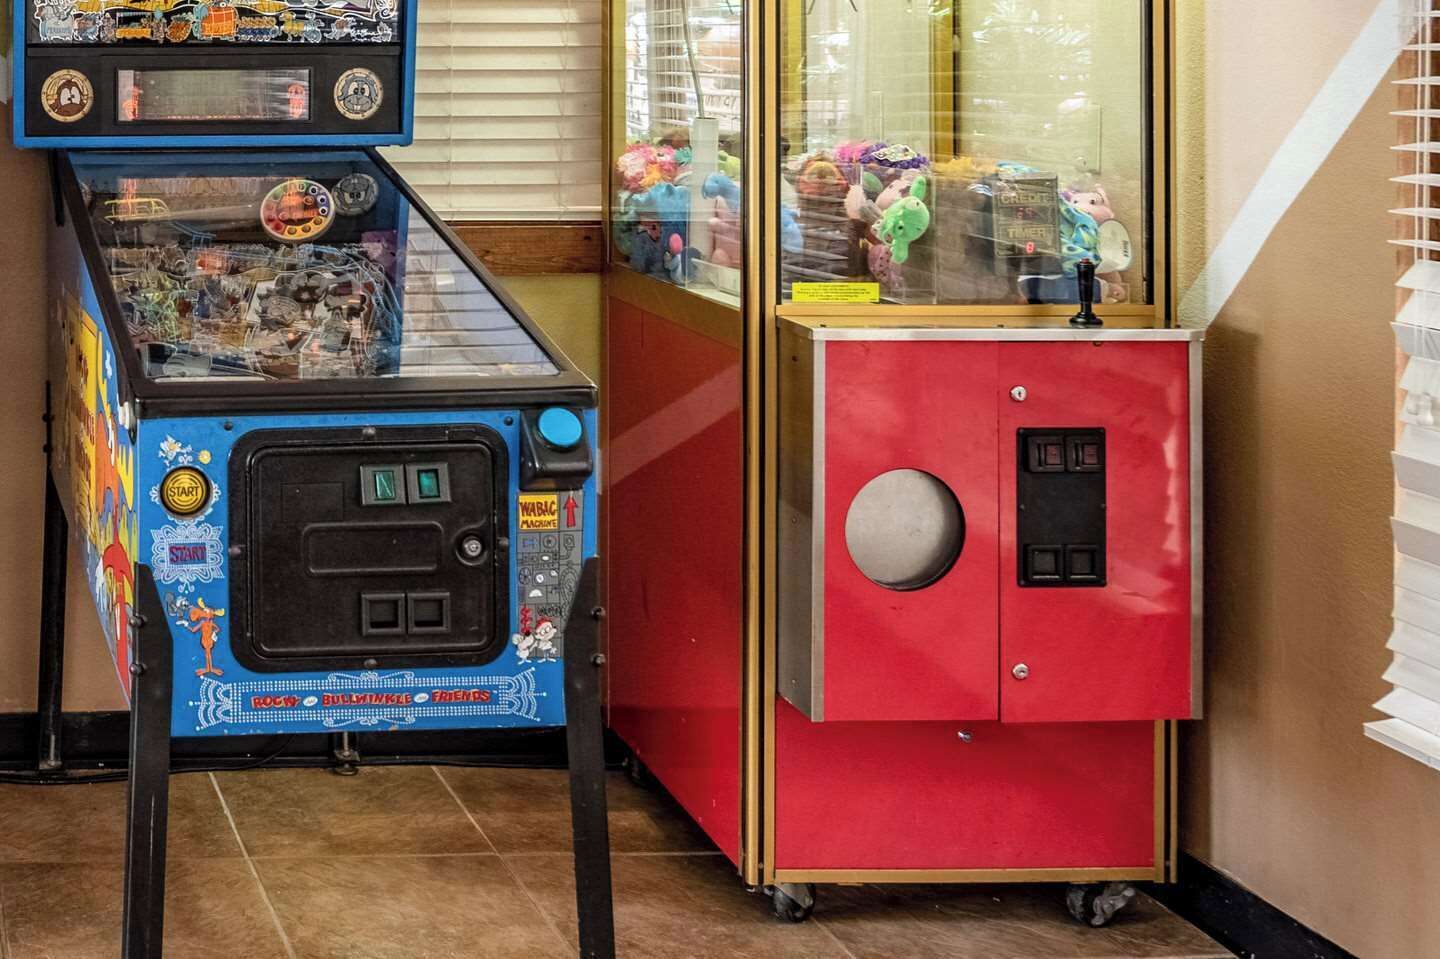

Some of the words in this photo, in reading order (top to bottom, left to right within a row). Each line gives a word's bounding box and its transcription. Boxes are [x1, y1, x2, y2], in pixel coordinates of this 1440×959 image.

[1007, 227, 1046, 239] TIMER
[169, 486, 200, 498] START
[519, 501, 556, 517] WABAC
[520, 519, 557, 528] MACHINE
[169, 545, 207, 563] START
[322, 692, 412, 707] BULLWINKLE
[432, 689, 491, 703] FRIENDS
